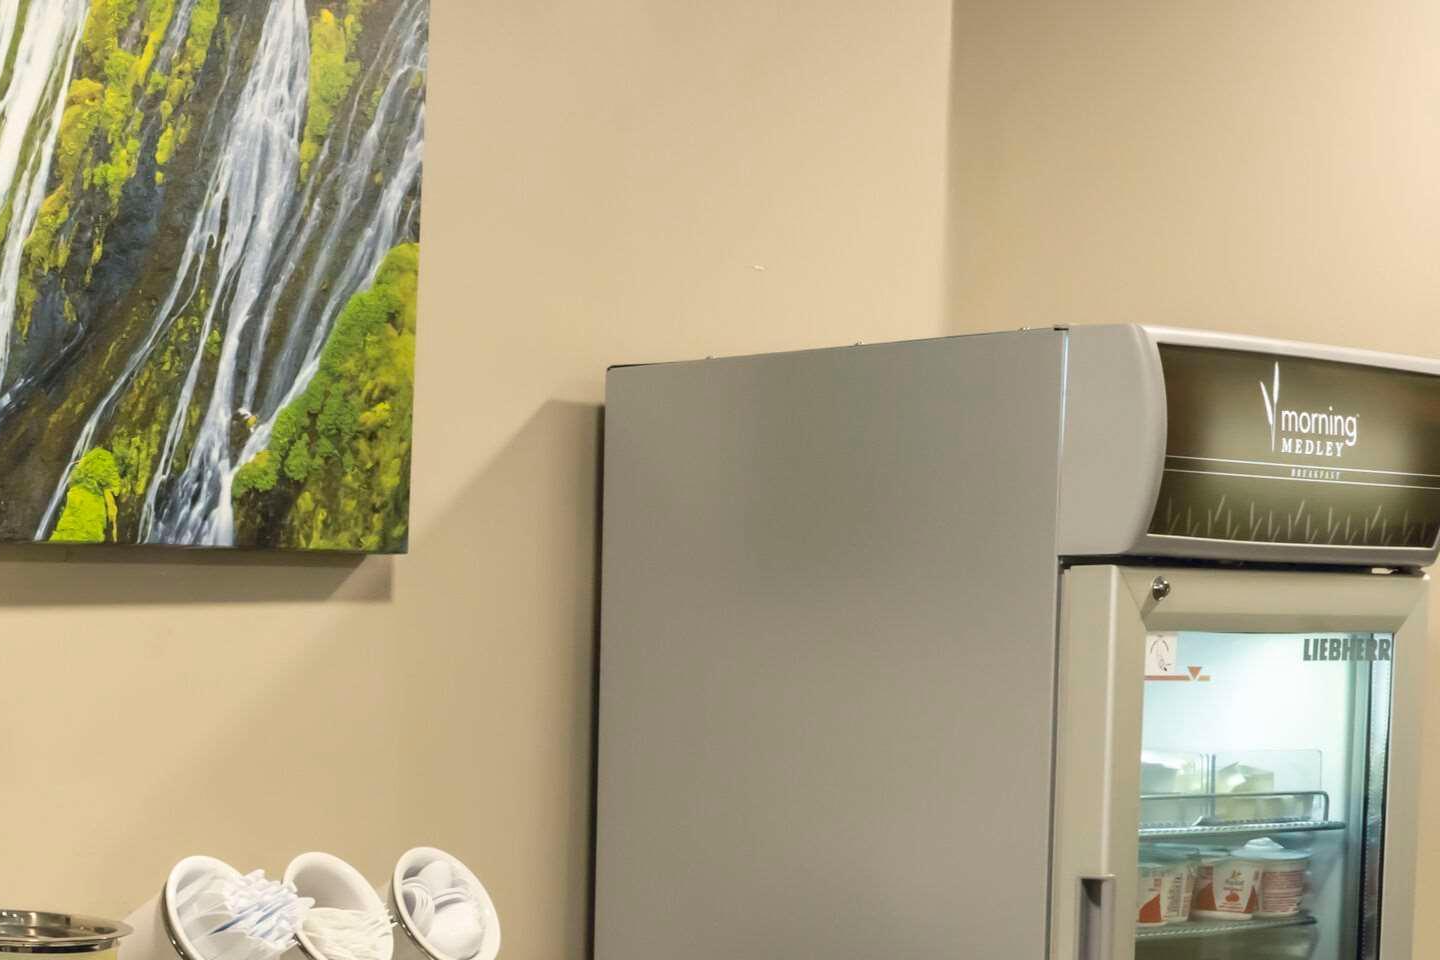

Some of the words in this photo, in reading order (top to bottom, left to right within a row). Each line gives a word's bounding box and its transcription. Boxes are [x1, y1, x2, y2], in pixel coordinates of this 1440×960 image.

[1281, 406, 1357, 446] morning
[1281, 437, 1344, 457] MEDLEY
[1291, 468, 1340, 481] BREAKFAST
[1303, 638, 1391, 661] LIEBHERR
